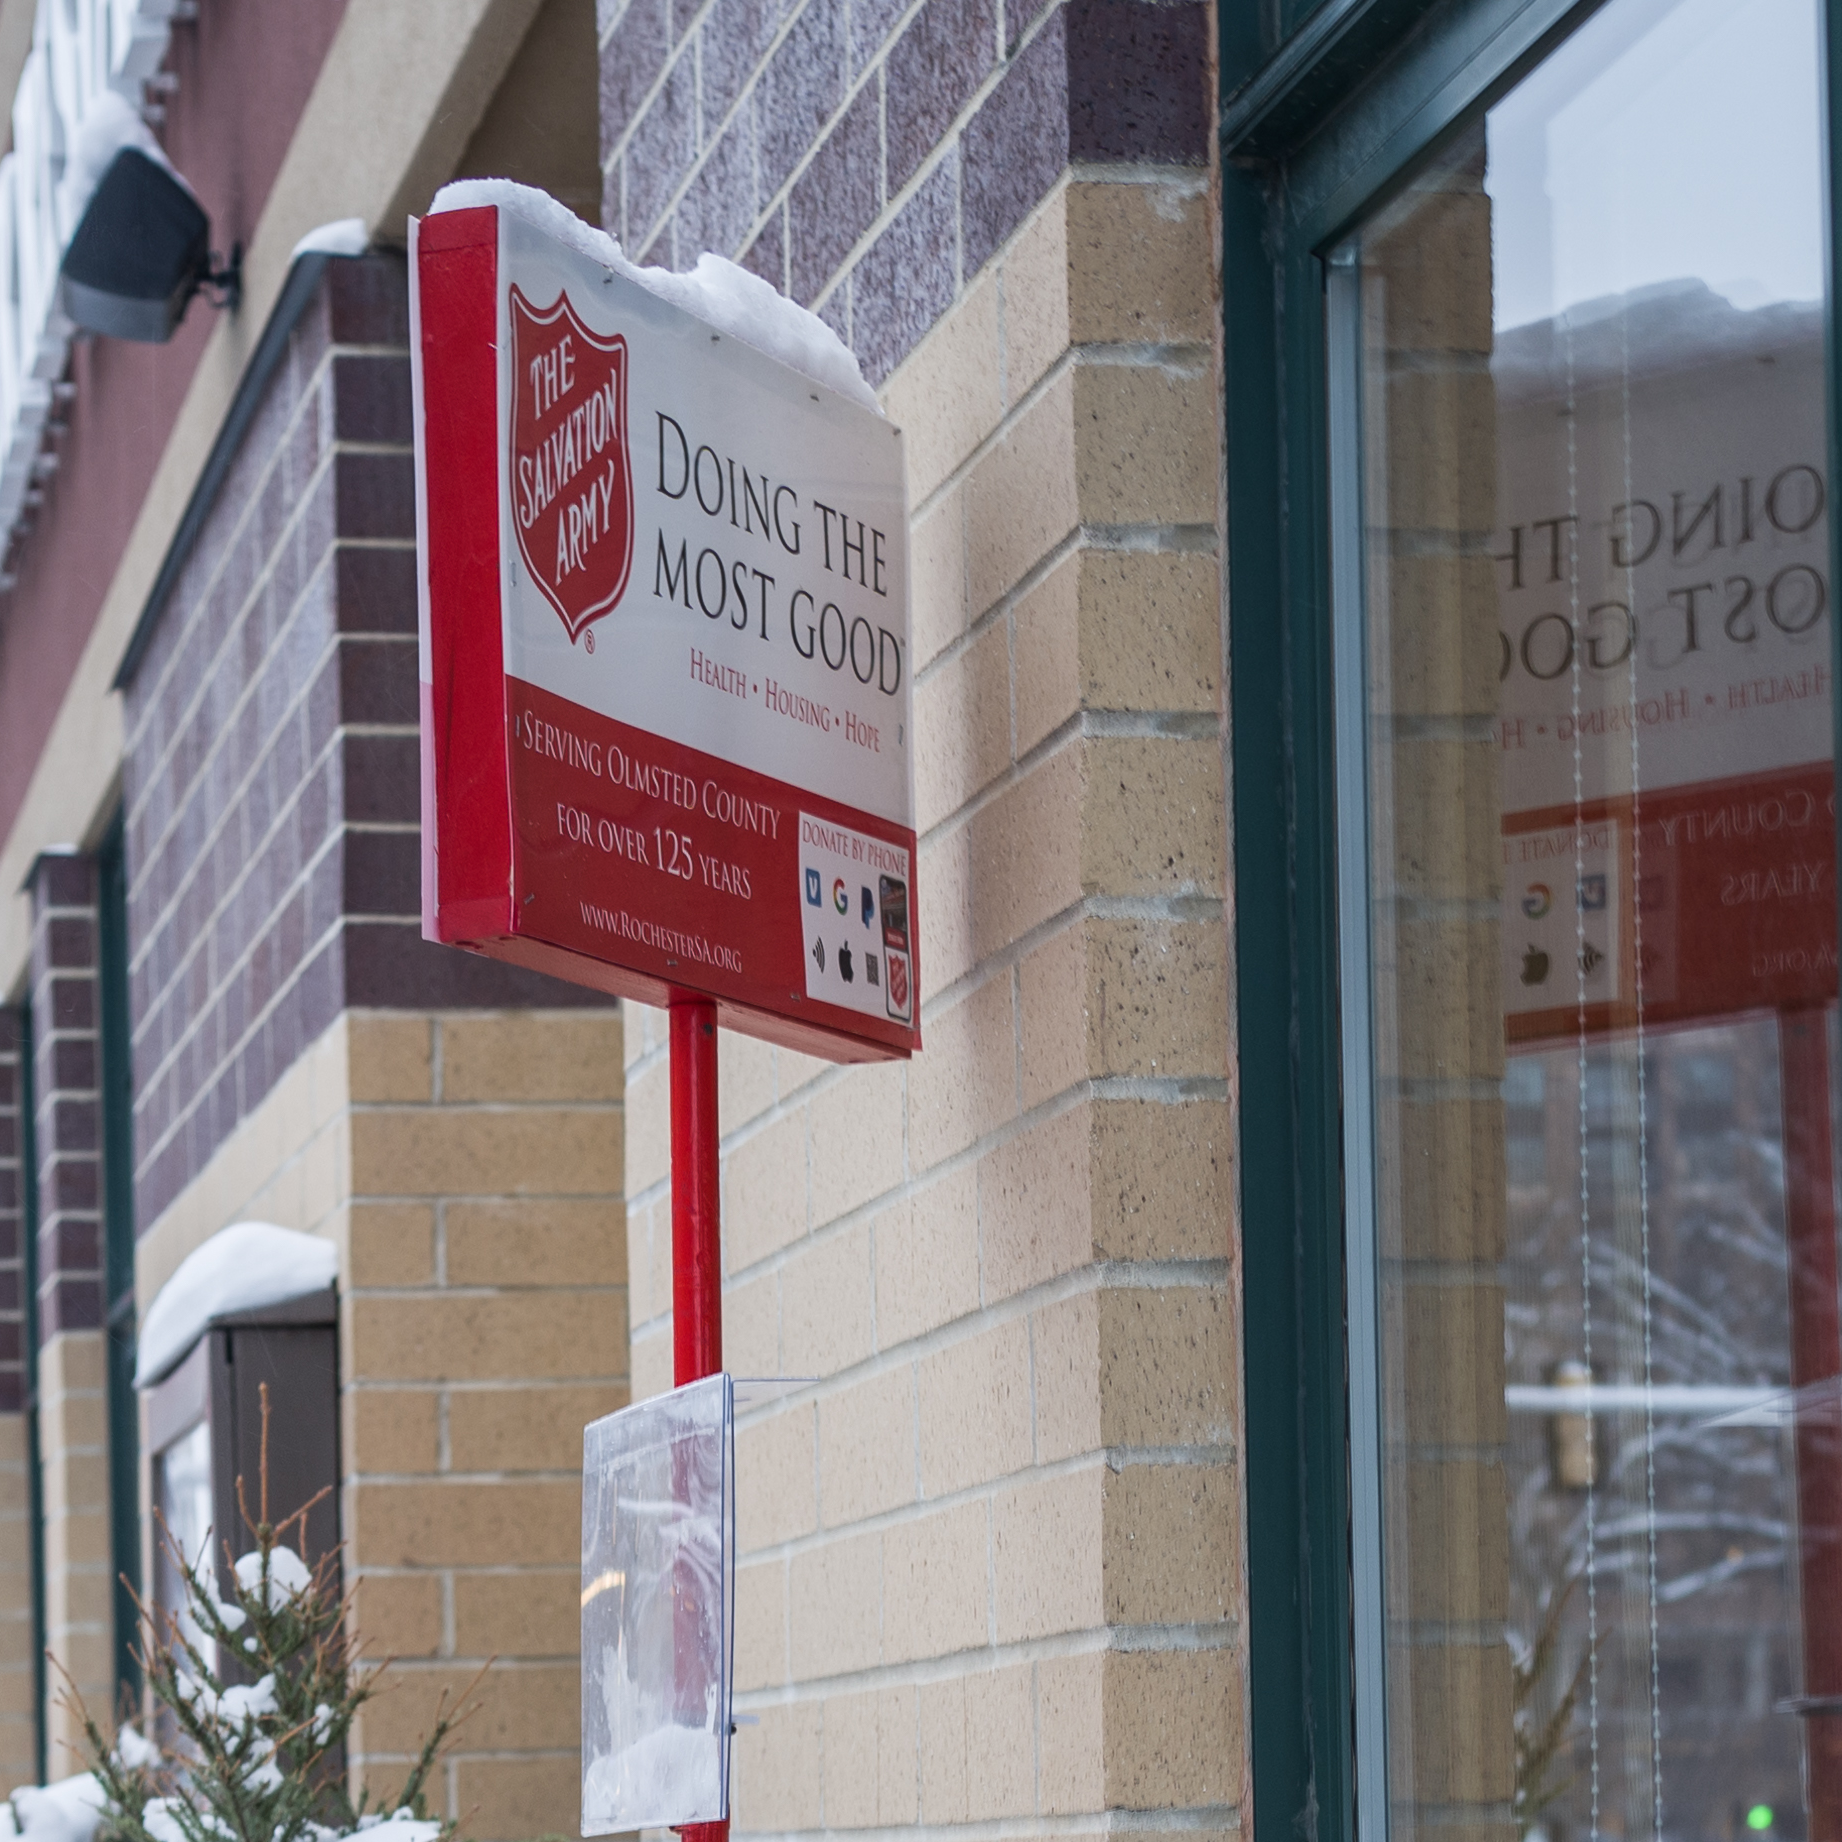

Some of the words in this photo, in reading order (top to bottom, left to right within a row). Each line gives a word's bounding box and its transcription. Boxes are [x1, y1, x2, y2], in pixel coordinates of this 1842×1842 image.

[530, 334, 576, 420] THE
[518, 367, 617, 529] SALVATION
[655, 410, 801, 555] DOING
[814, 500, 887, 597] THE
[555, 458, 615, 586] ARMY
[652, 527, 776, 641] MOST
[790, 589, 901, 696] GOOD
[690, 647, 747, 699] HEALTH
[765, 676, 831, 732] HOUSING
[845, 710, 881, 753] HOPE
[524, 710, 601, 776] SERVING
[607, 745, 697, 810] OLMSTED
[702, 779, 781, 839] COUNTY
[557, 802, 594, 848] FOR
[598, 819, 650, 866] OVER
[653, 826, 693, 880] 125
[699, 852, 752, 900] YEARS
[803, 819, 849, 857] DONATE
[852, 835, 866, 862] BY
[868, 843, 906, 877] PHONE
